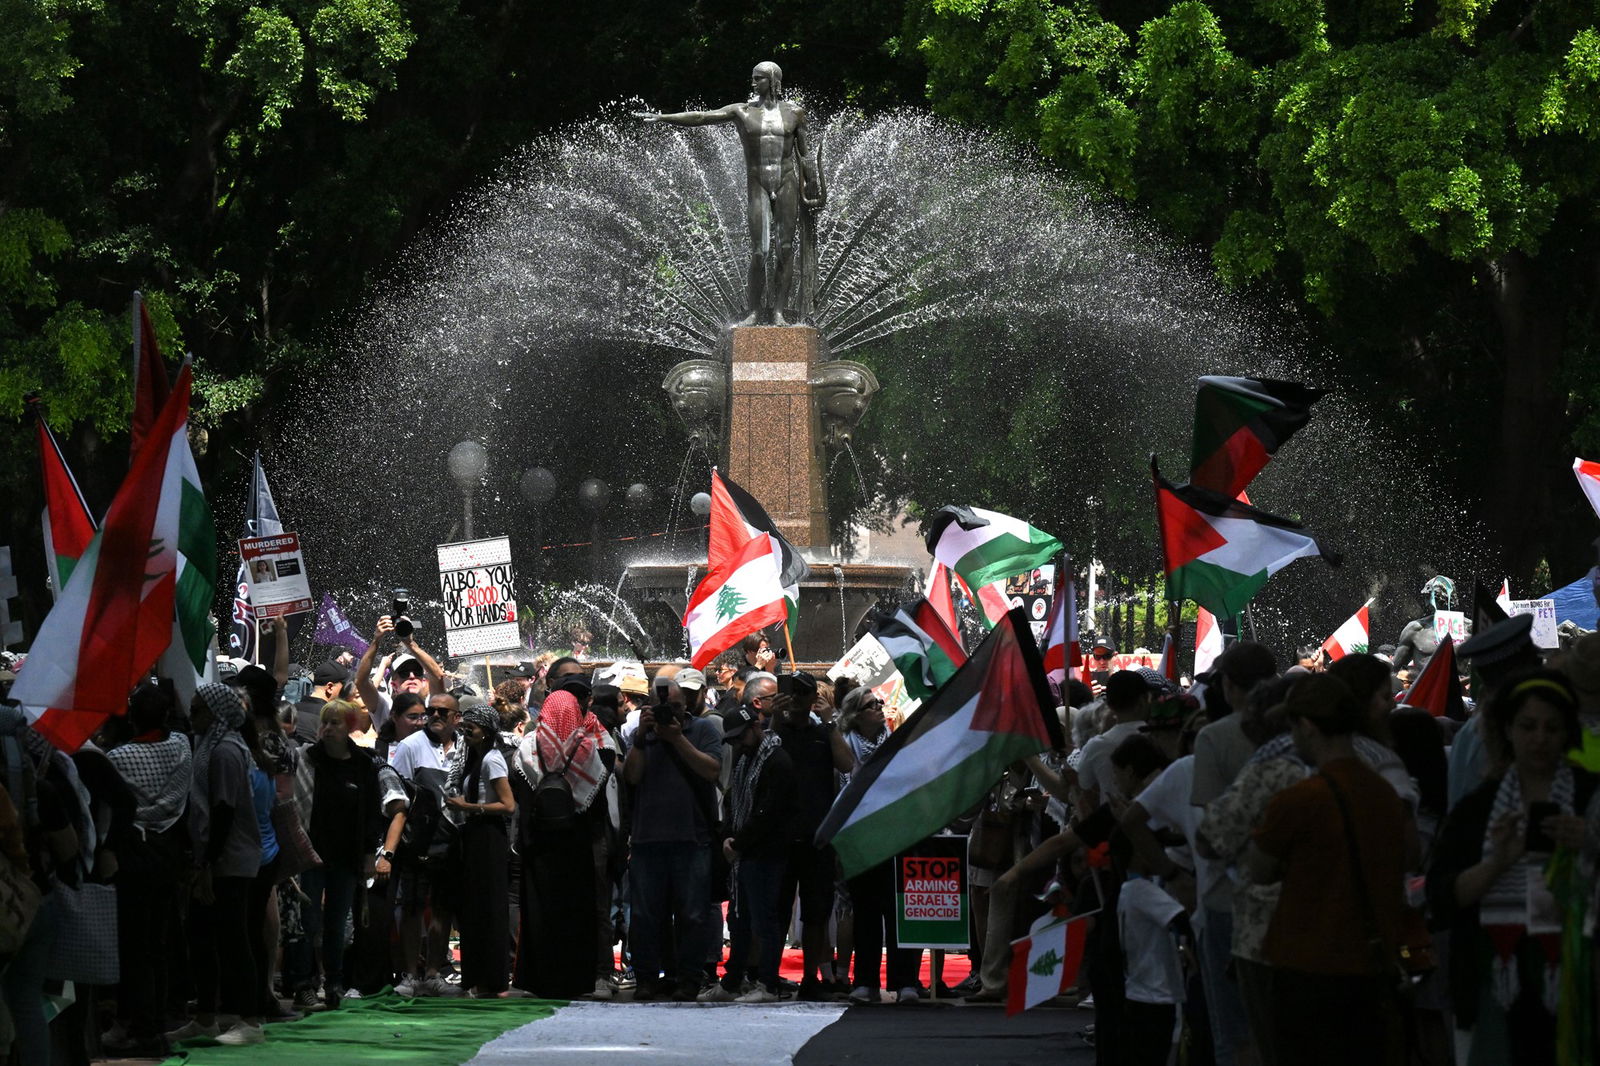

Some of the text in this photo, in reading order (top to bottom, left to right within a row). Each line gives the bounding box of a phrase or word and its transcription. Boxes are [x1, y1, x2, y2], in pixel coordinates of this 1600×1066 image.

[244, 537, 294, 550] MURDERED
[486, 565, 513, 586] YOU
[468, 586, 498, 608] BLOOD
[445, 602, 506, 627] YOUR HANDS
[906, 861, 960, 878] STOP
[904, 880, 958, 892] ARMING
[905, 894, 960, 906] ISRAEL'S
[905, 908, 959, 918] GENOCIDE
